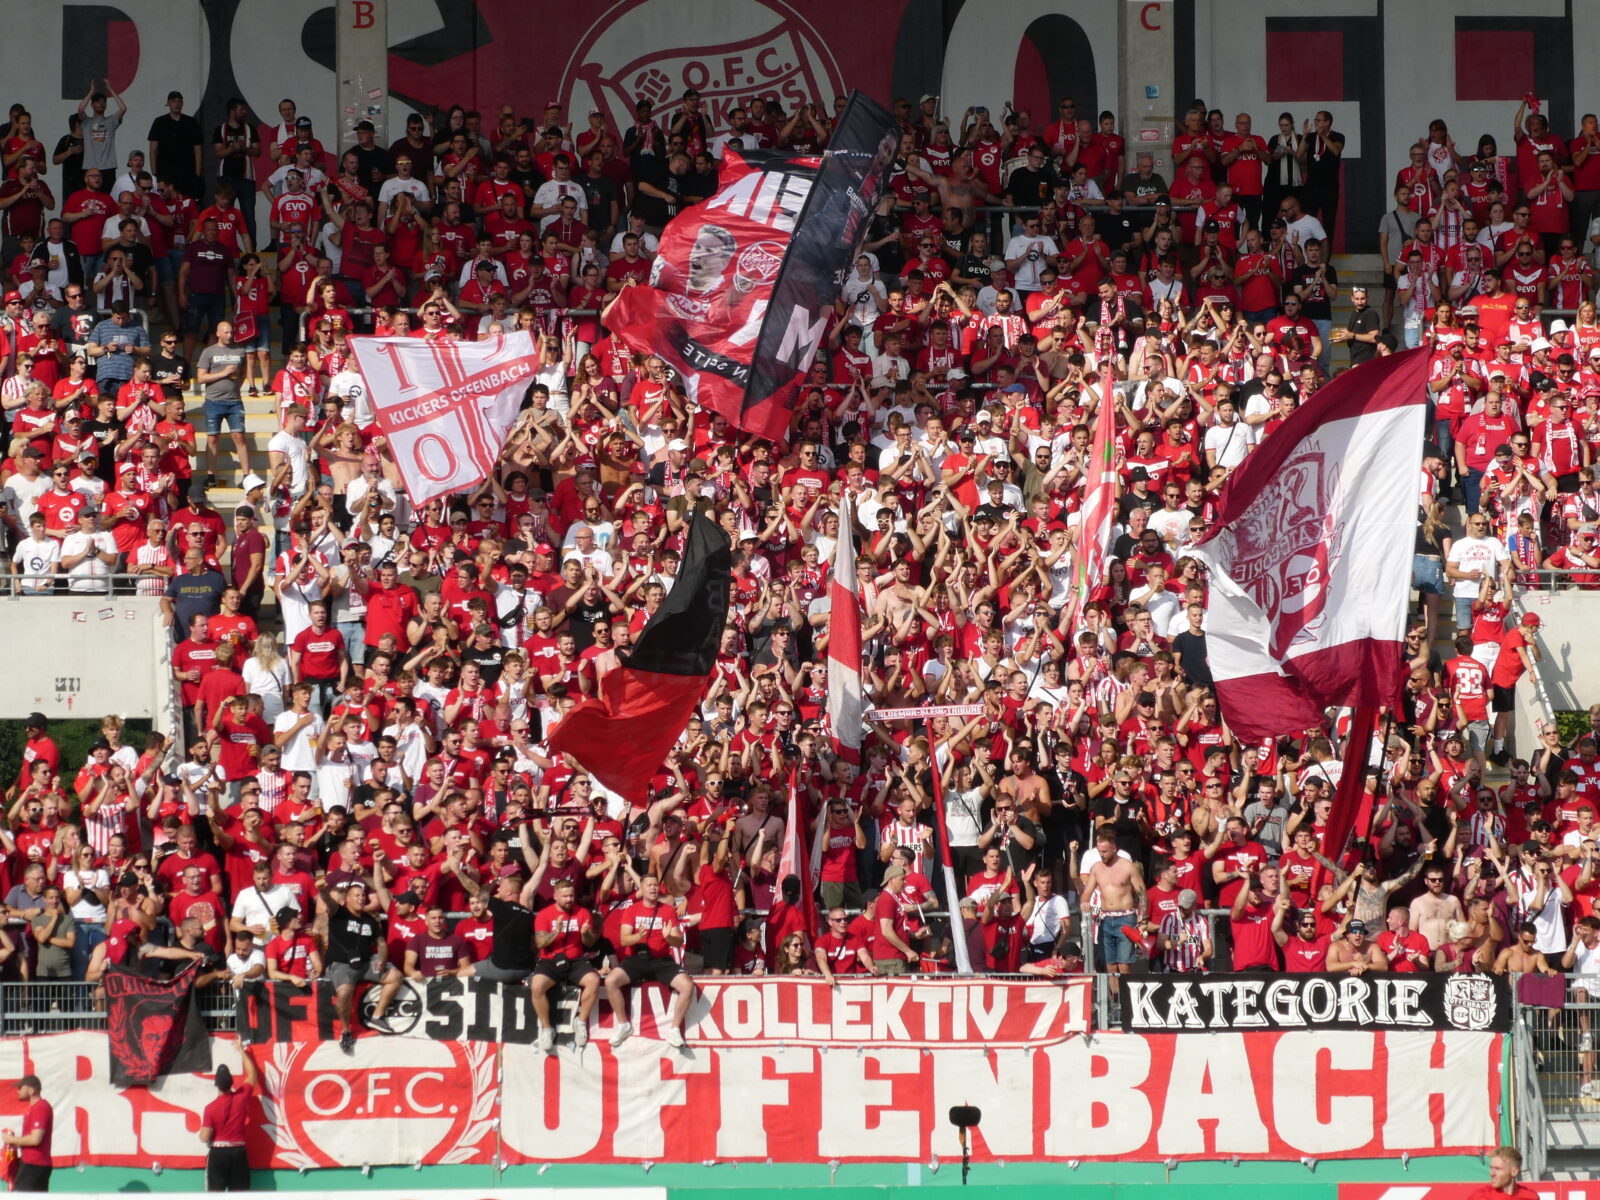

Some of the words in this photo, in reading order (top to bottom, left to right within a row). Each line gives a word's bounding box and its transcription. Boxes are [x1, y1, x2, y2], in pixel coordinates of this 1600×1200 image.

[352, 1, 375, 29] B
[1140, 3, 1161, 31] C
[682, 47, 792, 91] O.F.C.
[285, 202, 307, 211] EVO
[218, 222, 232, 230] EVO
[975, 267, 990, 275] EVO
[1521, 285, 1536, 293] EVO
[389, 391, 450, 427] KICKERS
[450, 362, 531, 403] OFFENBACH
[1455, 667, 1482, 694] 33
[1025, 984, 1087, 1040] 71
[1127, 976, 1434, 1030] KATEGORIE
[303, 1072, 459, 1116] O.F.C.
[500, 1029, 1497, 1160] OFFENBACH
